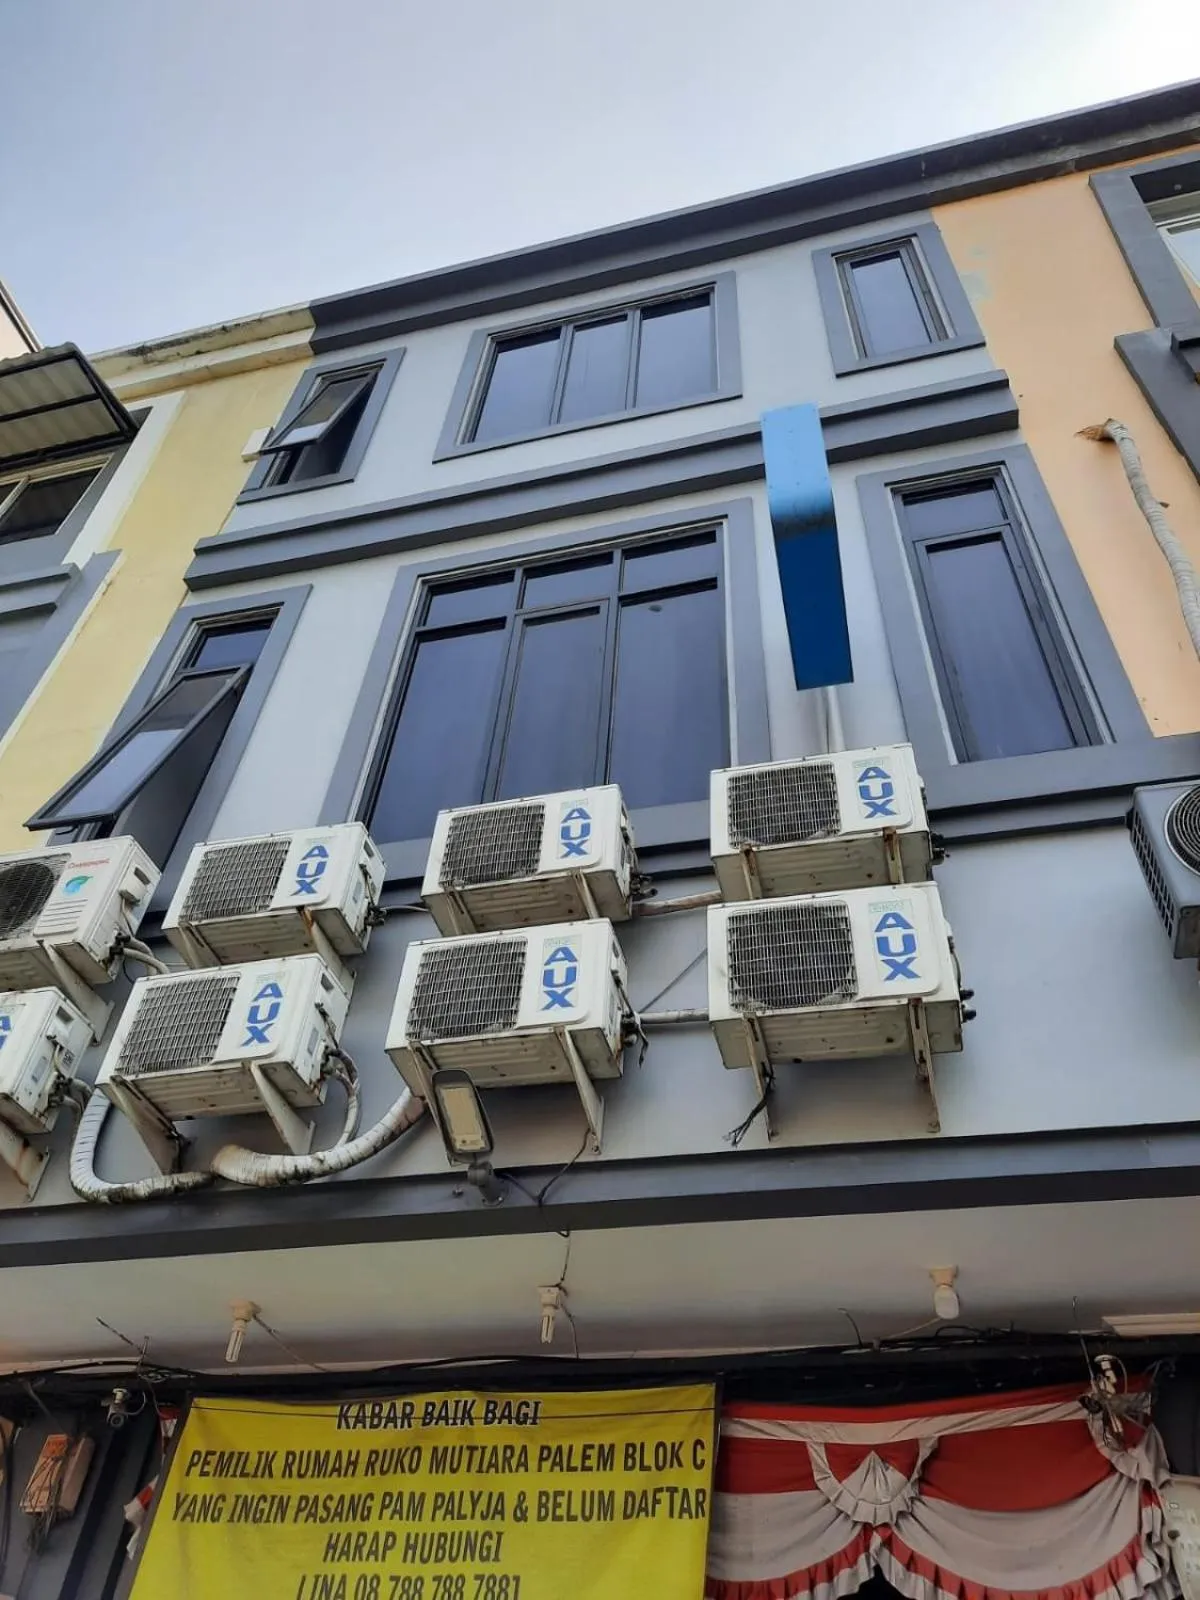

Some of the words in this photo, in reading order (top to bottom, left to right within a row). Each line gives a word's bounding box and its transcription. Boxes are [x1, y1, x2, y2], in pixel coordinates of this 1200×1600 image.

[857, 767, 897, 818] AUX
[560, 807, 592, 859] AUX
[290, 845, 329, 896] AUX
[874, 912, 921, 981] AUX
[541, 946, 578, 1011] AUX
[241, 983, 284, 1047] AUX
[337, 1401, 415, 1430] KABAR
[421, 1399, 477, 1426] BAIK
[483, 1400, 541, 1426] BAGI
[185, 1450, 277, 1479] PEMILIK
[281, 1449, 360, 1479] RUMAH
[364, 1446, 422, 1477] RUKO
[428, 1445, 529, 1475] MUTIARA
[537, 1443, 616, 1473] PALEM
[623, 1440, 685, 1472] BLOK
[692, 1438, 706, 1471] C
[172, 1492, 226, 1523] YANG
[227, 1493, 291, 1524] INGIN
[293, 1492, 374, 1524] PASANG
[378, 1491, 426, 1523] PAM
[431, 1490, 505, 1523] PALYJA
[512, 1490, 529, 1523] &
[536, 1489, 616, 1522] BELUM
[622, 1486, 707, 1521] DAFTAR
[322, 1531, 397, 1563] HARAP
[402, 1530, 505, 1564] HUBUNGI
[353, 1573, 382, 1600] 08
[388, 1574, 425, 1600] 788
[431, 1573, 466, 1600] 788
[473, 1573, 522, 1600] 7881
